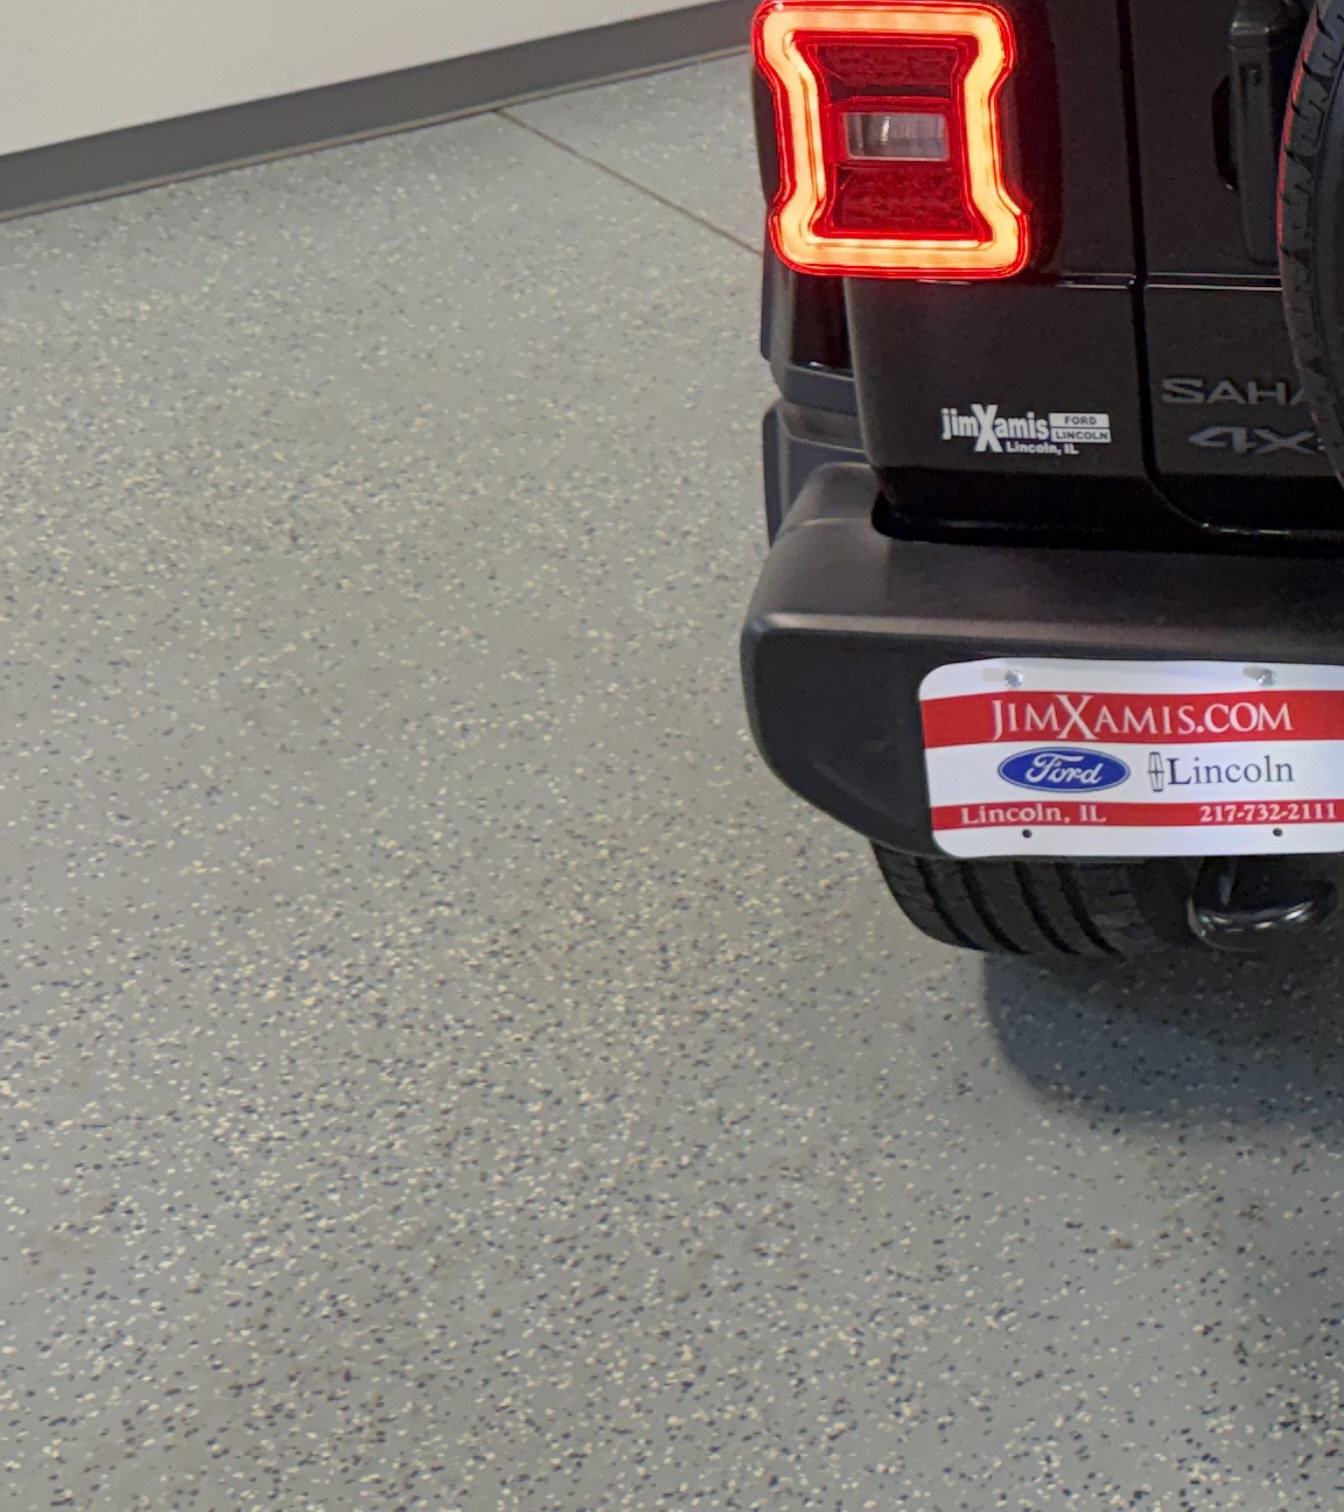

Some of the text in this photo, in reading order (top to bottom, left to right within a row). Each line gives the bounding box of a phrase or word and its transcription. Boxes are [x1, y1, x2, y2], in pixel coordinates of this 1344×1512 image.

[1064, 414, 1098, 426] FORD
[1055, 429, 1108, 441] LINCOLN
[1005, 440, 1079, 456] Lincoln, IL
[1024, 753, 1103, 785] Ford
[1166, 754, 1294, 787] Lincoln
[1078, 804, 1107, 824] IL
[1199, 802, 1337, 824] 217-732-2111
